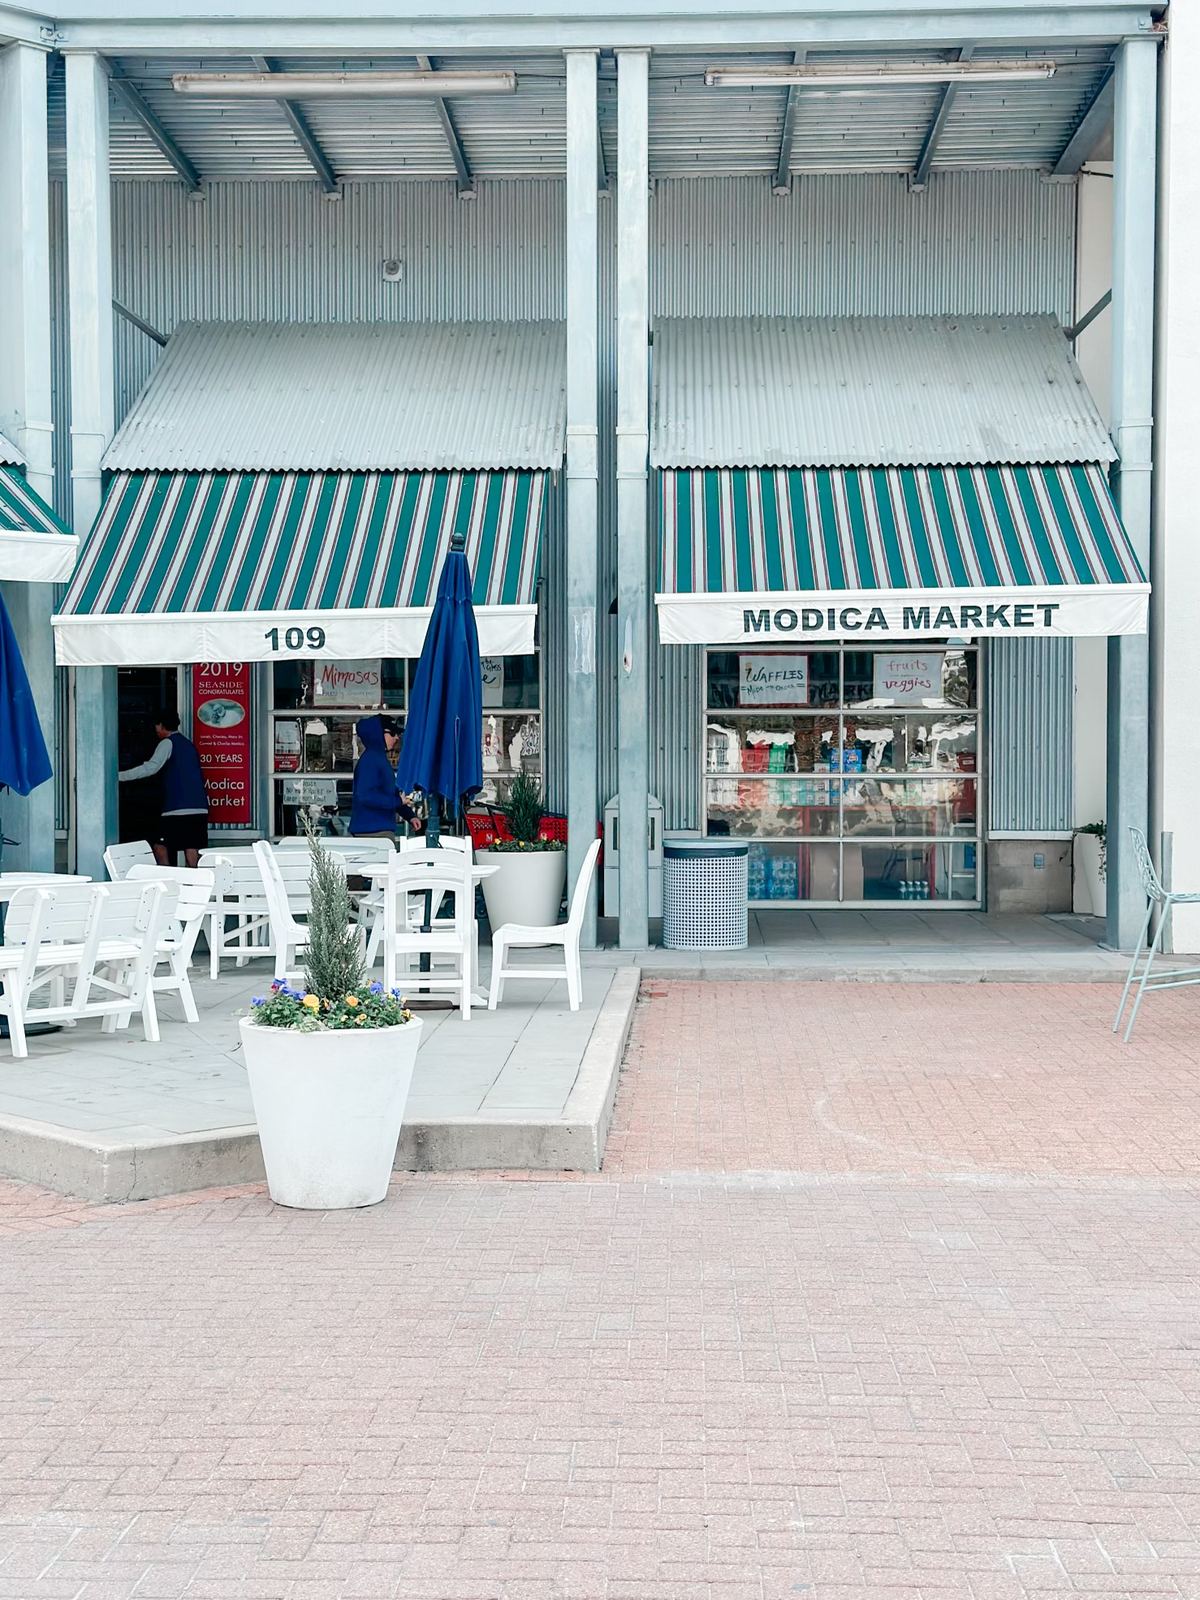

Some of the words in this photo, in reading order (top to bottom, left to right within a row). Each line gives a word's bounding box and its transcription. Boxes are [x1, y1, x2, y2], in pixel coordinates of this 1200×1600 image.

[743, 606, 889, 632] MODICA
[902, 603, 1060, 629] MARKET
[264, 626, 326, 651] 109
[200, 662, 243, 677] 2019
[888, 659, 928, 671] fruits
[321, 663, 379, 689] Mimosas
[198, 681, 244, 689] SEASIDE
[882, 677, 931, 692] veggies
[200, 754, 212, 763] 30
[214, 754, 243, 763] YEARS
